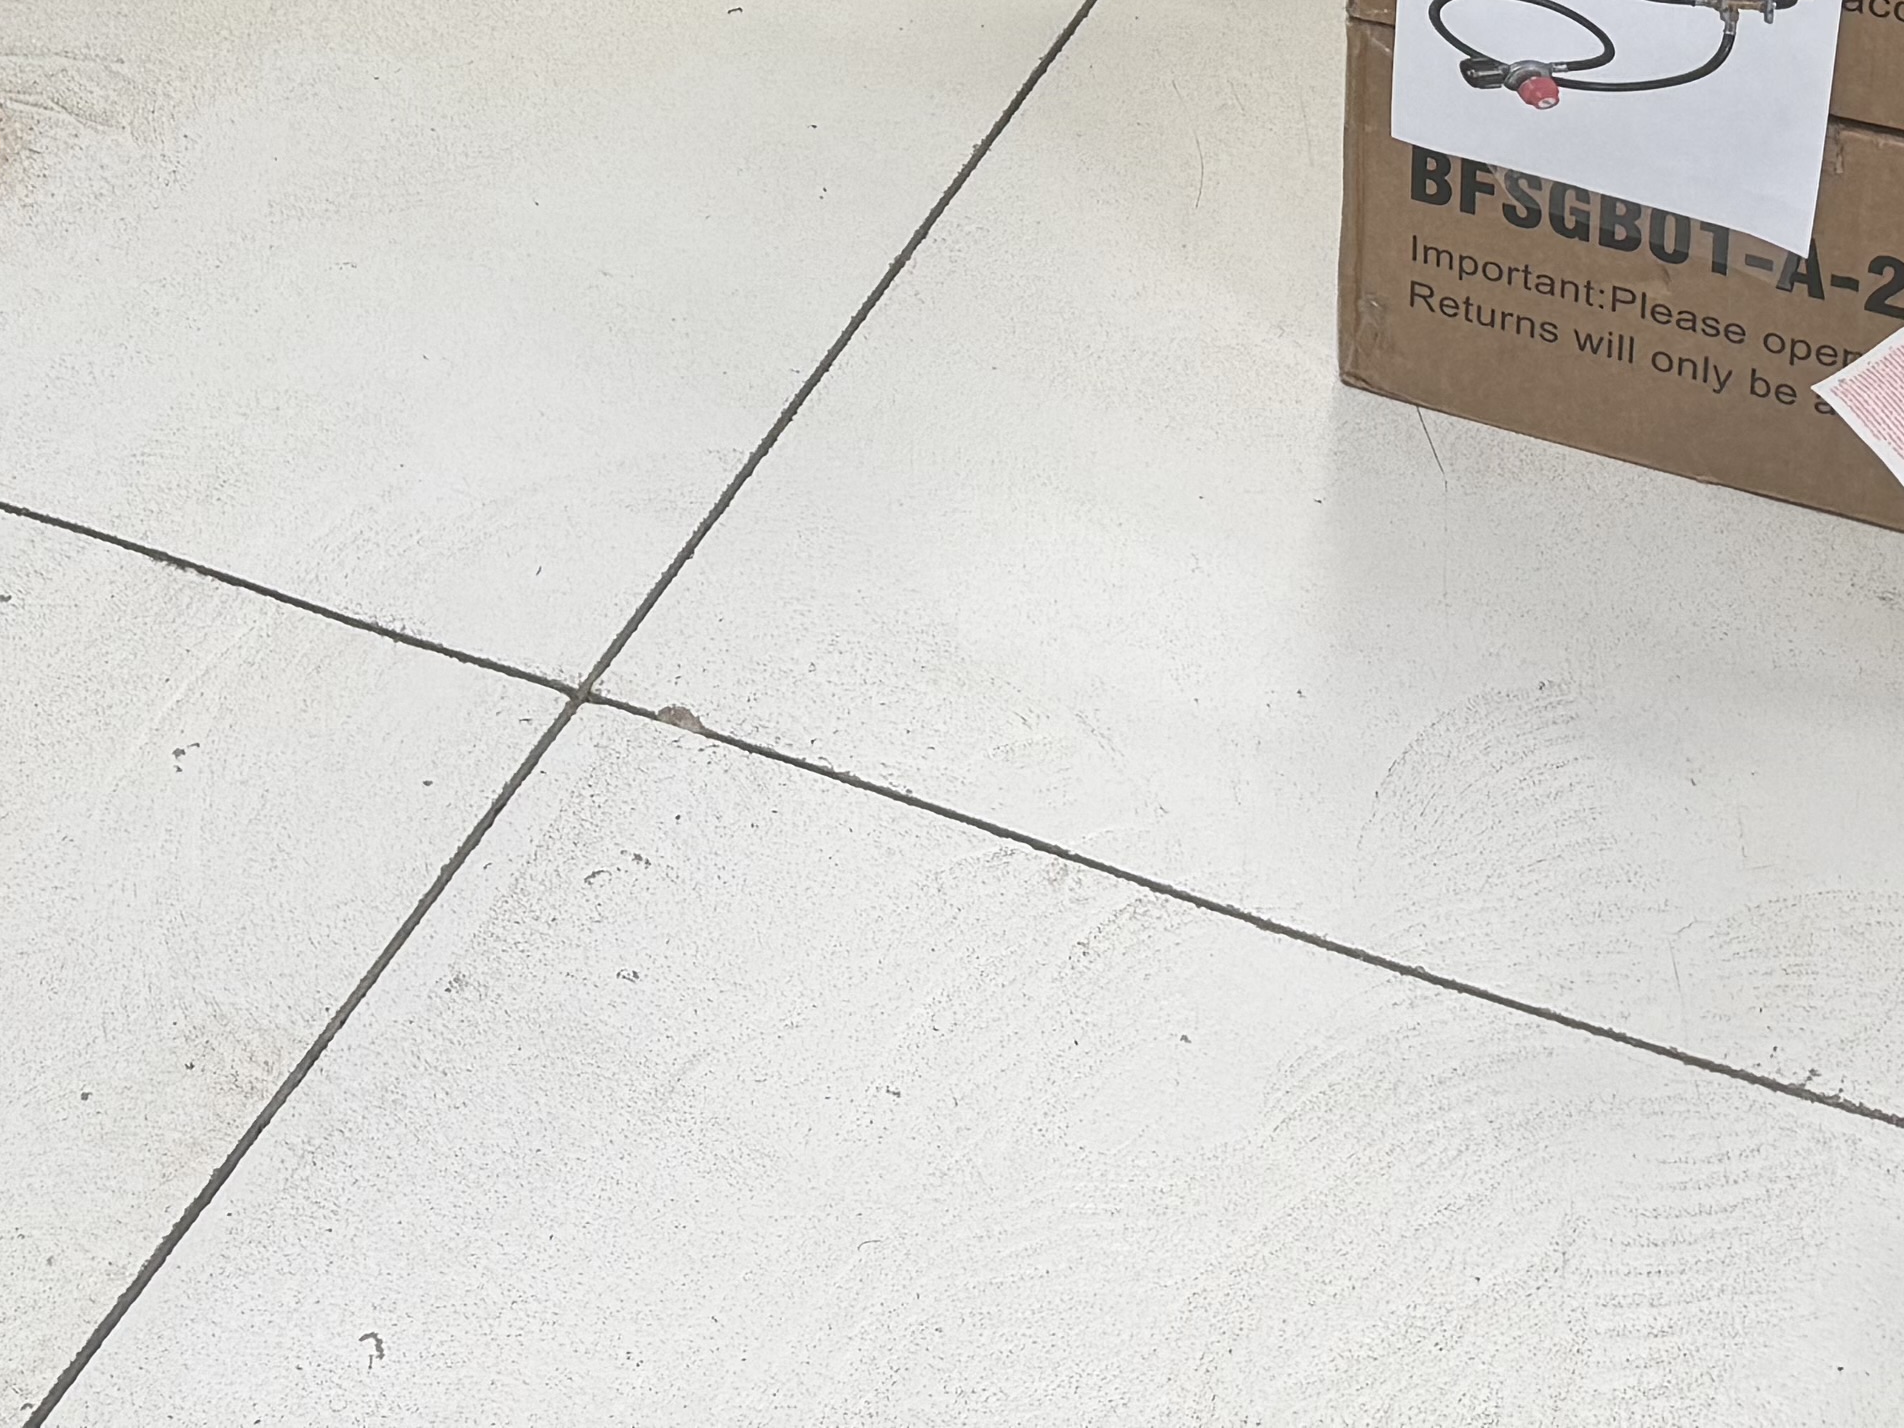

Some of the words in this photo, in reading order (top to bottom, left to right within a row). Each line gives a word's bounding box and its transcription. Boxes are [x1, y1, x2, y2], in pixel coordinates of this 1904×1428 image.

[1409, 281, 1560, 345] Returns
[1573, 325, 1637, 365] will
[1651, 347, 1733, 396] only
[1749, 368, 1797, 408] be
